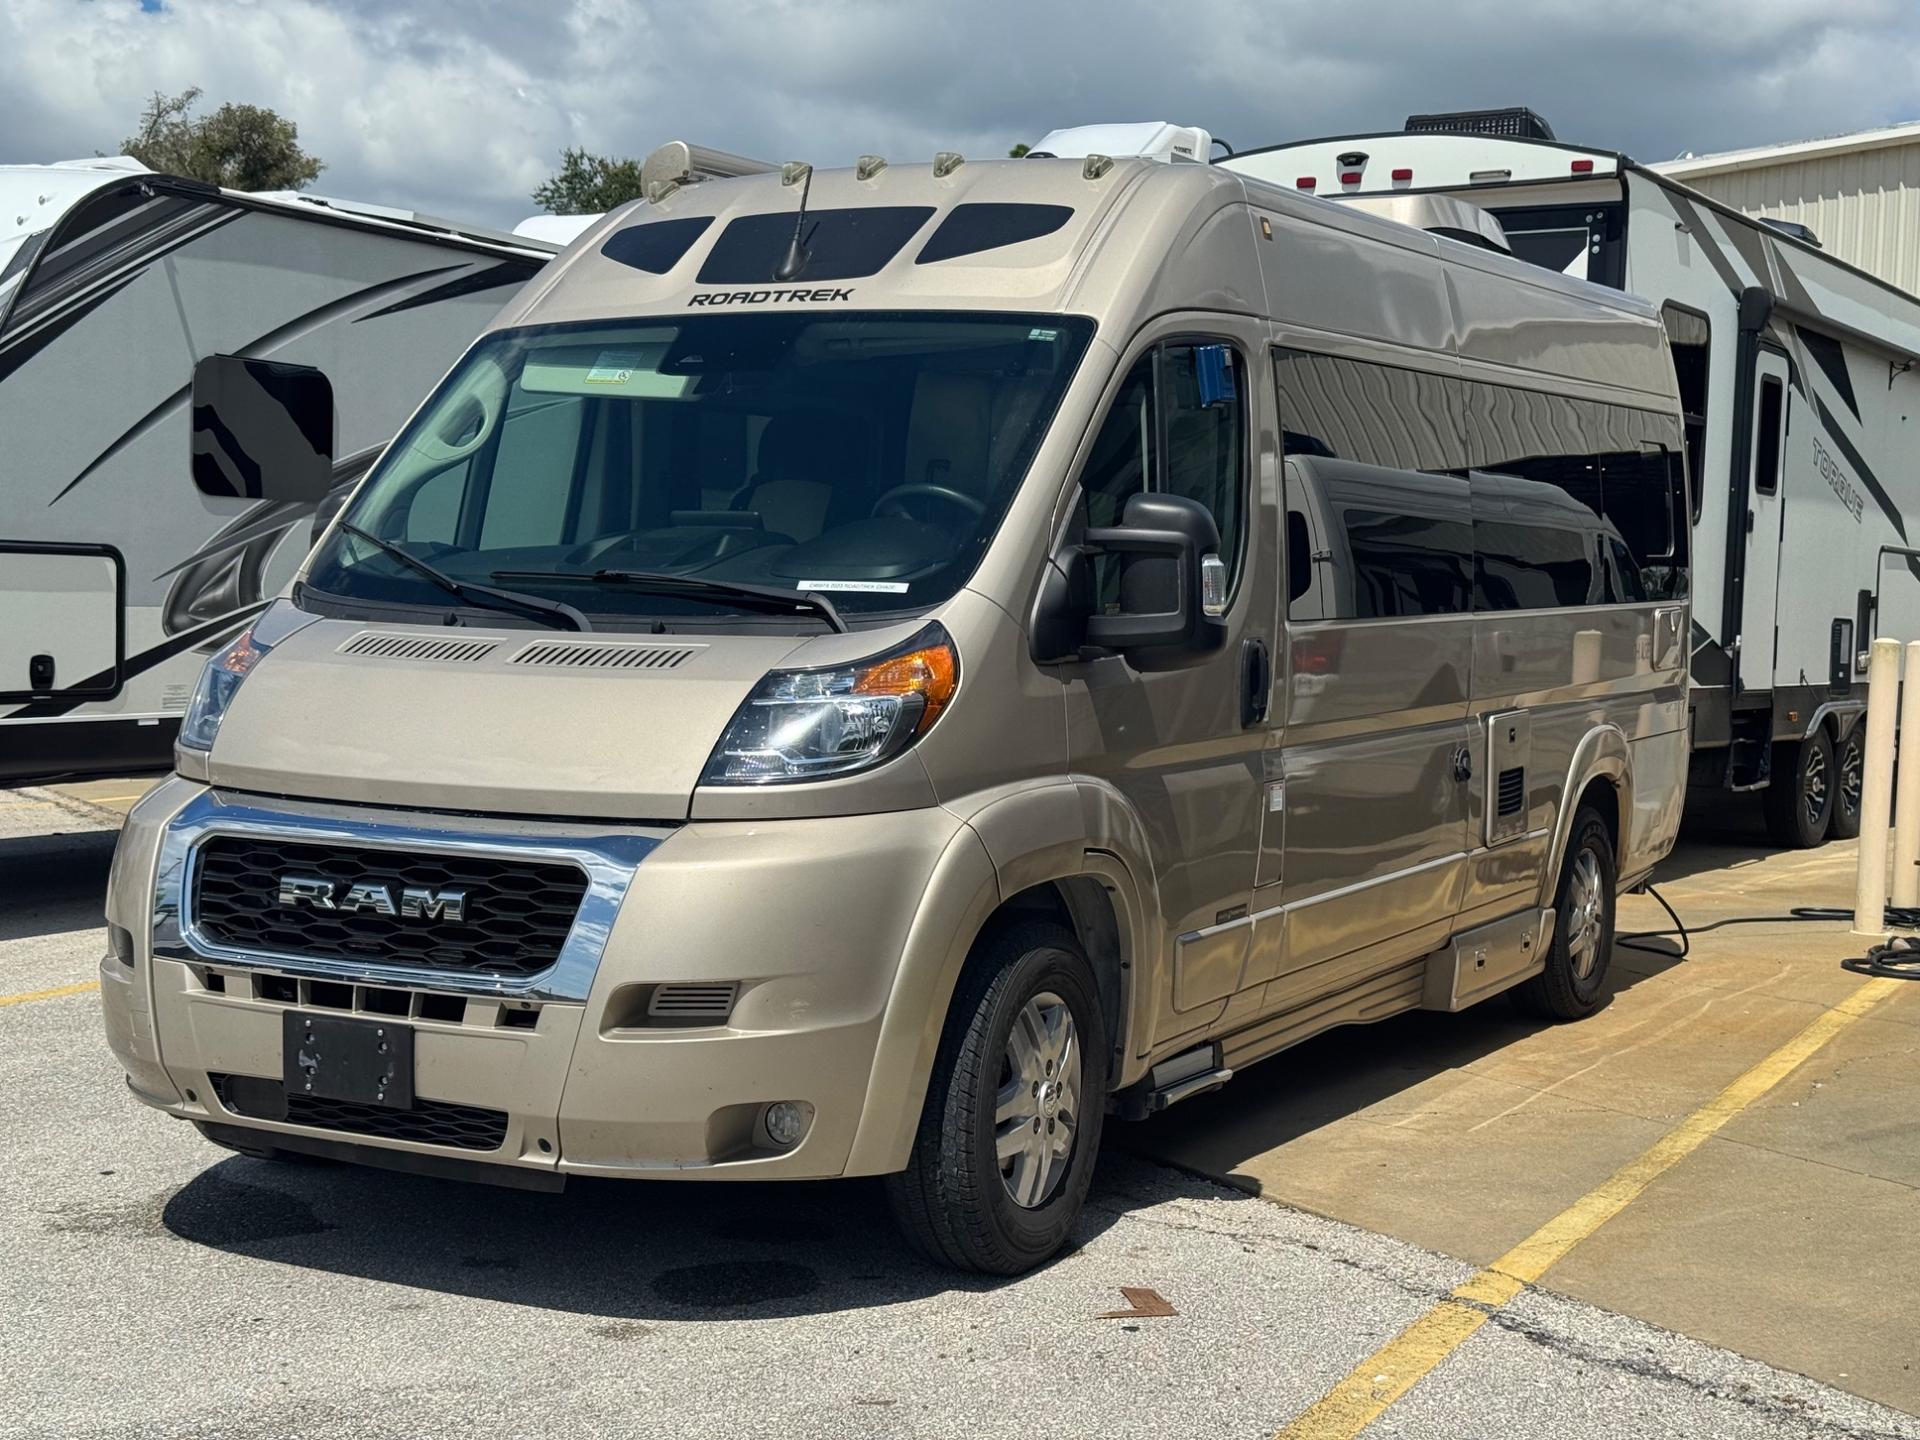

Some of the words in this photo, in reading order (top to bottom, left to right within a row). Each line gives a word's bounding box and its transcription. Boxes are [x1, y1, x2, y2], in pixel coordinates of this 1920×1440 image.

[687, 288, 856, 307] ROADTREK
[1813, 436, 1864, 524] TORQUE
[279, 875, 467, 922] RAM
